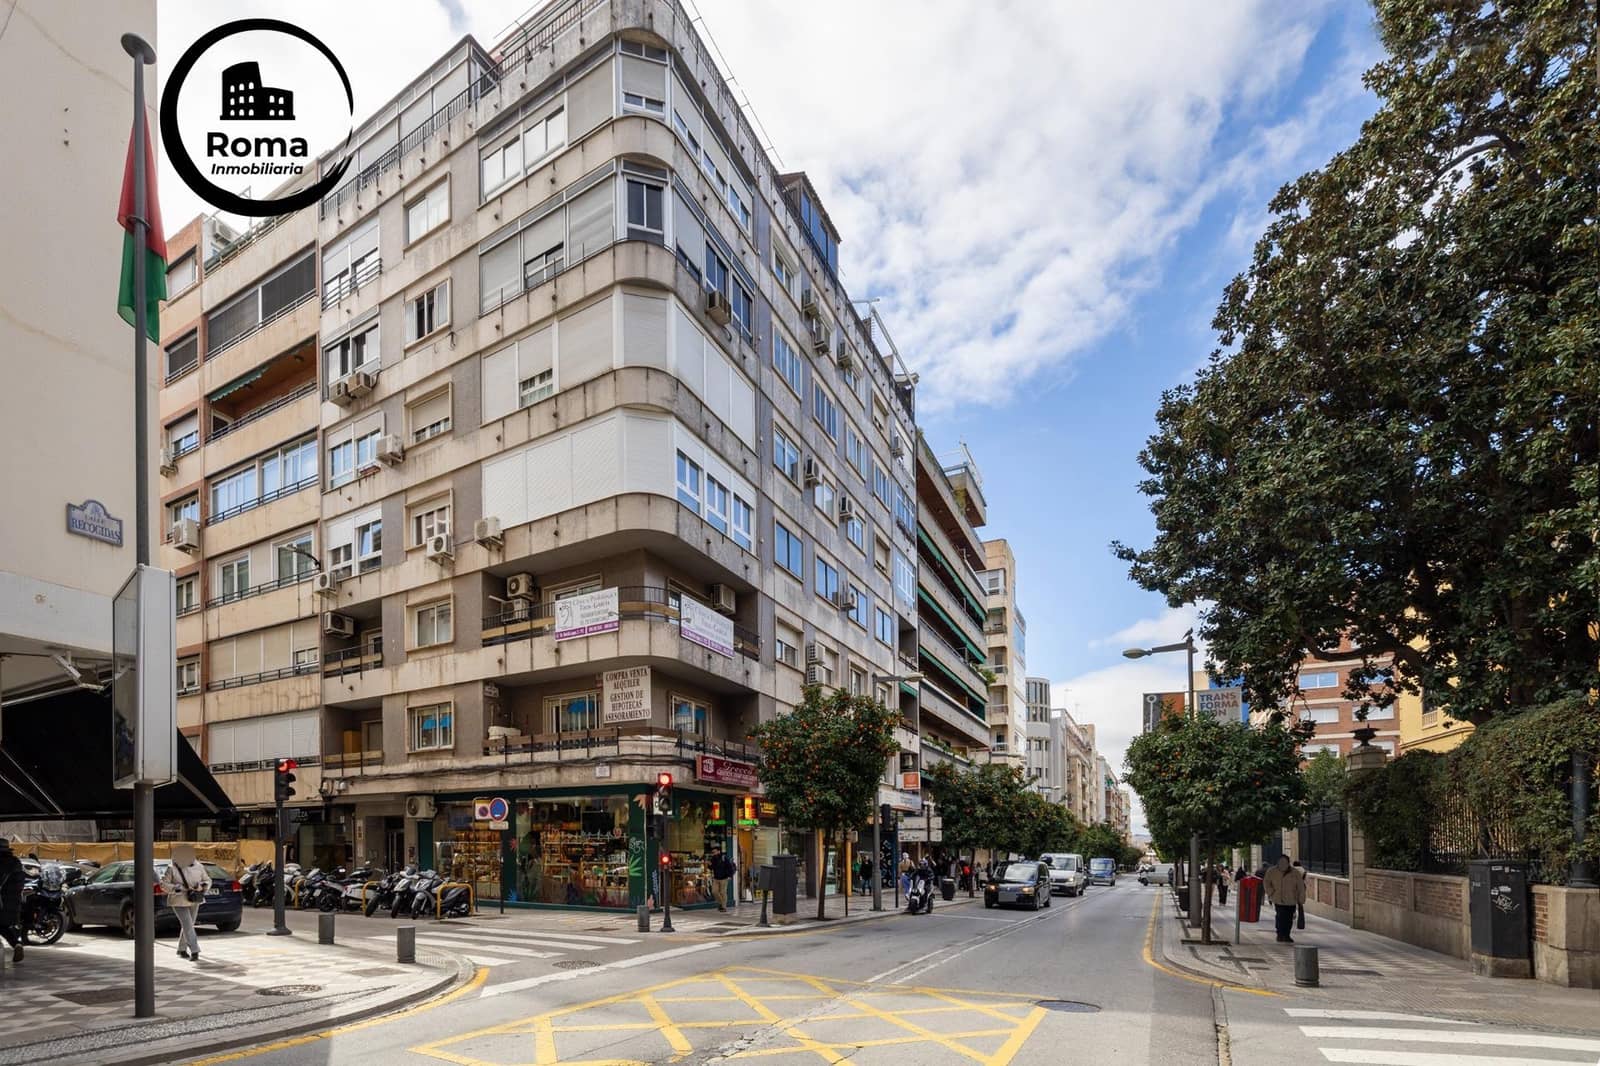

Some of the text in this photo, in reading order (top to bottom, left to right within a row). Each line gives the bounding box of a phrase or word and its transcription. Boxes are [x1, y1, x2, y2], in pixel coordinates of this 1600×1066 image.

[605, 668, 648, 681] COMPRA VENTA
[613, 679, 641, 691] ALQUILER
[635, 690, 644, 699] DE
[1200, 692, 1236, 701] TRANS
[611, 700, 643, 711] HIPOTECAS
[1200, 700, 1239, 709] FORMA
[605, 709, 650, 721] ASESORAMIENTO
